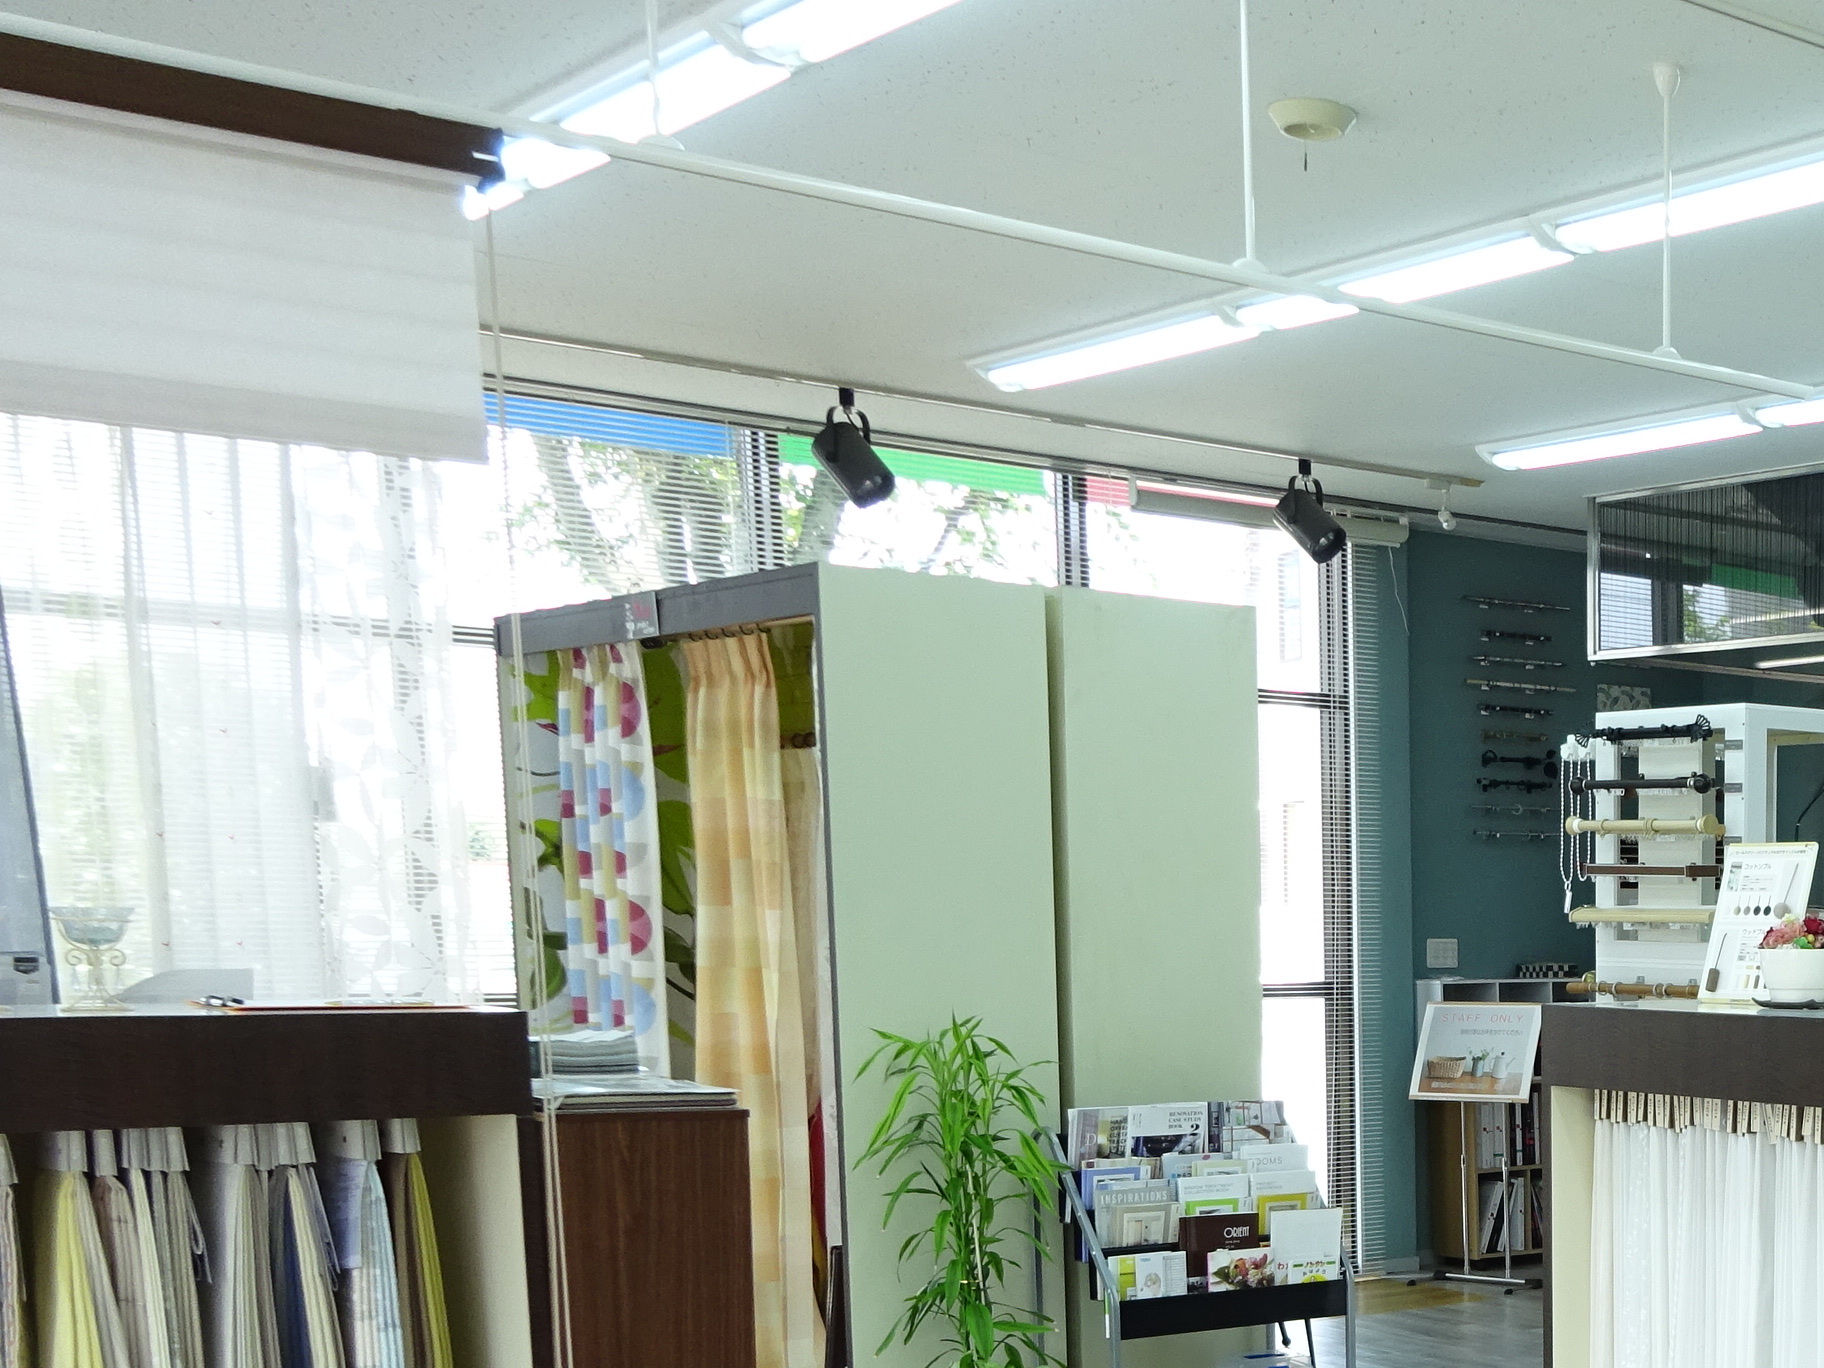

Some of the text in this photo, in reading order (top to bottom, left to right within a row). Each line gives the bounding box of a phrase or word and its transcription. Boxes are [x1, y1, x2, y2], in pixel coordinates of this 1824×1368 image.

[1441, 1013, 1524, 1023] STAFF ONLY
[1101, 1190, 1168, 1205] INSPIRATIONS
[1223, 1226, 1250, 1238] ORIENT
